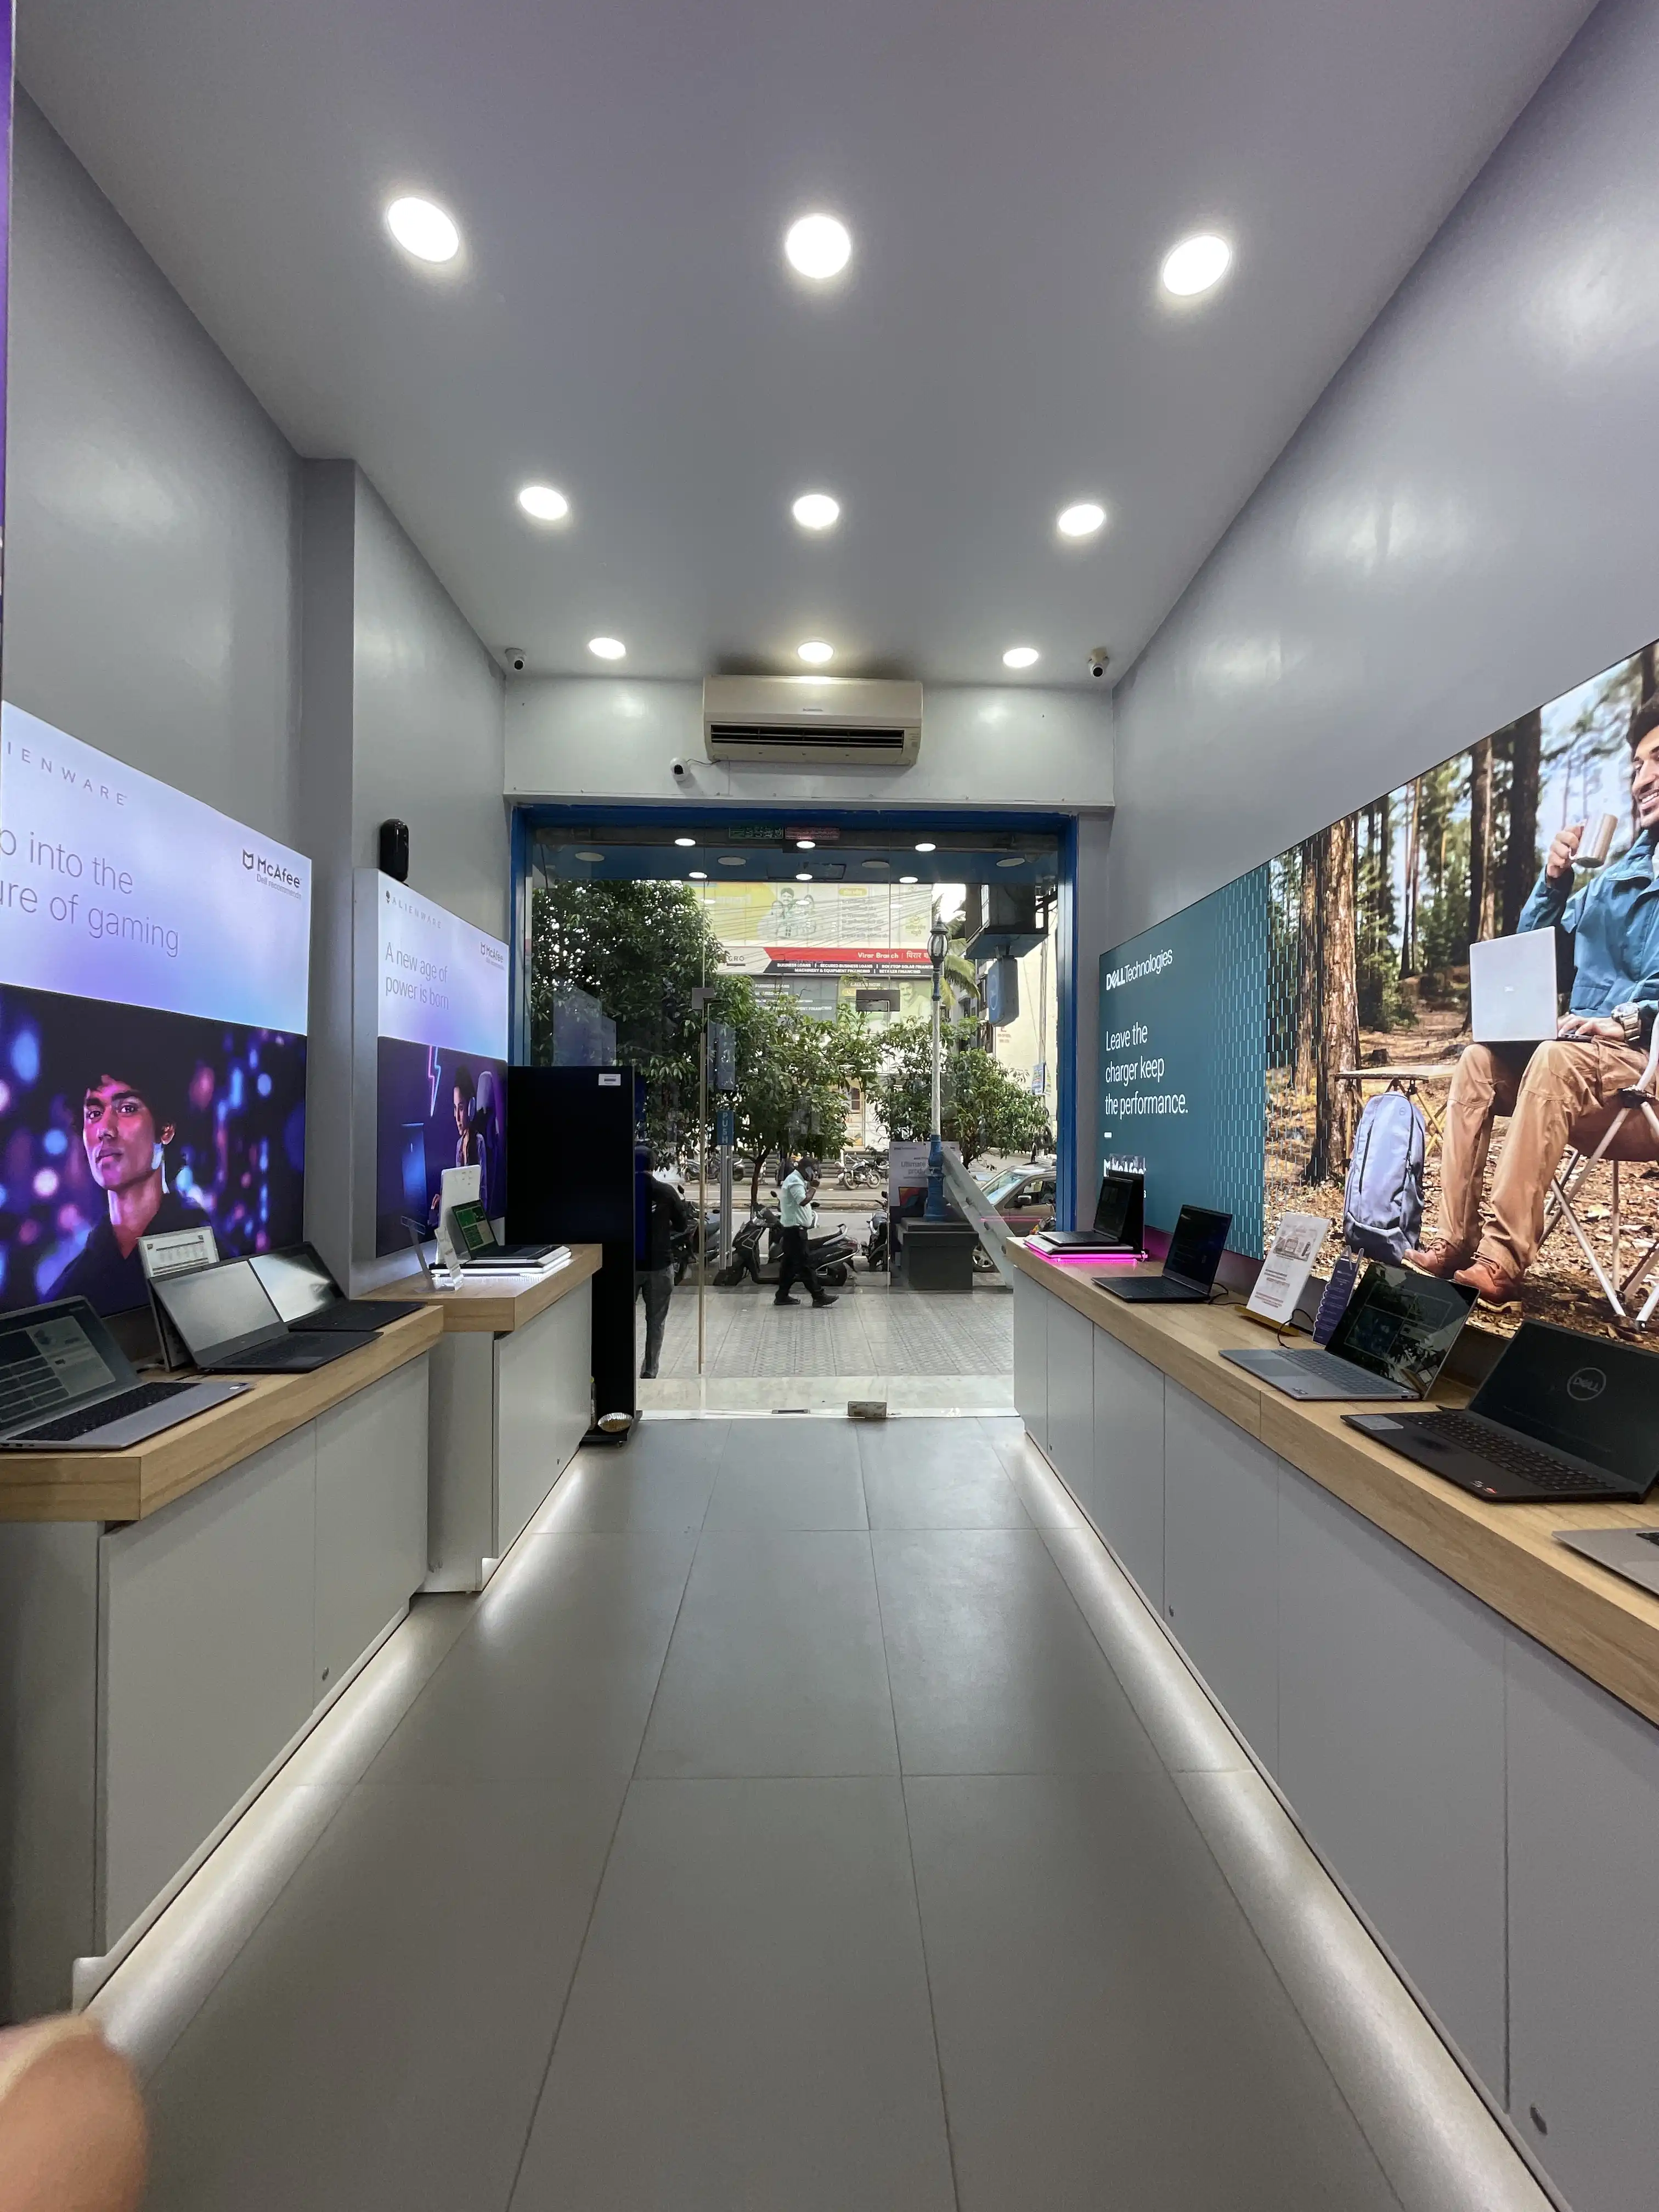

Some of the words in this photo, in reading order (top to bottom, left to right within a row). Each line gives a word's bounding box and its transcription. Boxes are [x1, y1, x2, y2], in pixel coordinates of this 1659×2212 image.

[30, 831, 83, 878] into
[92, 857, 133, 894] the
[257, 855, 300, 888] McAfee
[0, 880, 37, 913] re
[50, 894, 79, 925] of
[88, 907, 179, 958] gaming
[392, 896, 441, 929] ALIENWARE
[385, 942, 394, 963] A
[397, 950, 417, 972] new
[420, 960, 437, 981] age
[439, 966, 448, 983] of
[1106, 968, 1126, 991] DELL
[1124, 949, 1173, 983] Technologies
[386, 977, 417, 1000] power
[420, 984, 427, 1003] is
[430, 988, 449, 1010] born
[1105, 1030, 1131, 1052] Leave
[1132, 1022, 1148, 1045] the
[1105, 1061, 1138, 1087] charger
[1140, 1056, 1165, 1082] keep
[1105, 1093, 1119, 1115] the
[1120, 1091, 1188, 1120] performance.
